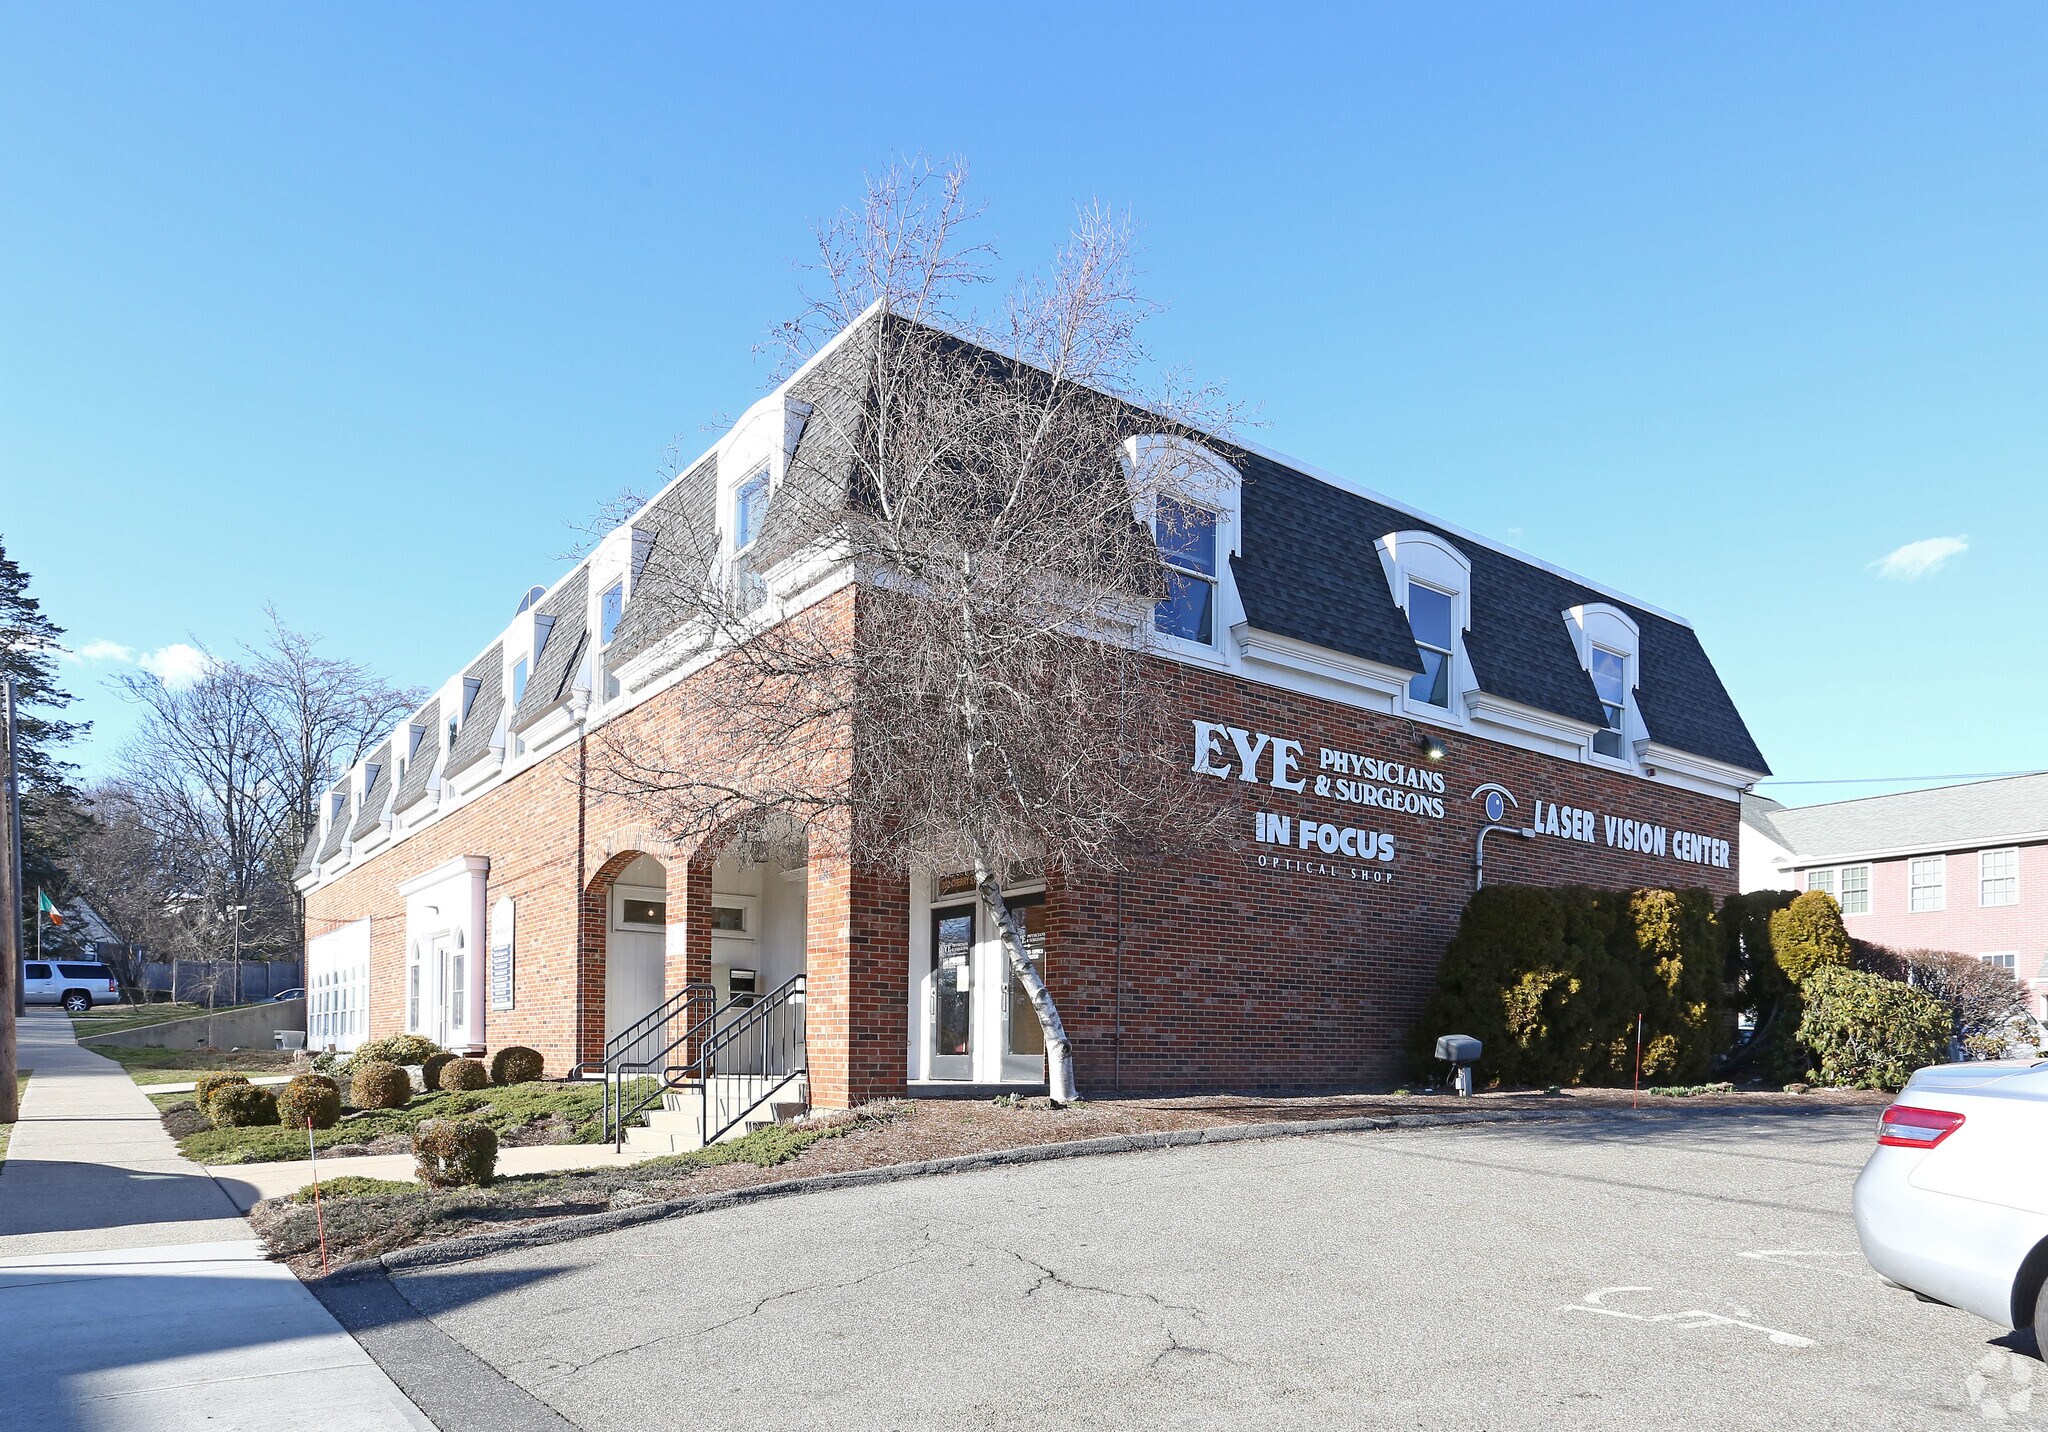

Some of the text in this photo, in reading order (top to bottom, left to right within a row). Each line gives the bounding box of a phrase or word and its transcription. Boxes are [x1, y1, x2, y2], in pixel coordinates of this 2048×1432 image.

[1192, 719, 1445, 794] EYE PHYSICIANS
[1314, 774, 1445, 819] & SURGEONS
[1255, 811, 1395, 862] IN FOCUS
[1534, 800, 1730, 869] LASER VISION CENTER
[1258, 855, 1393, 883] OPTICAL SHOP
